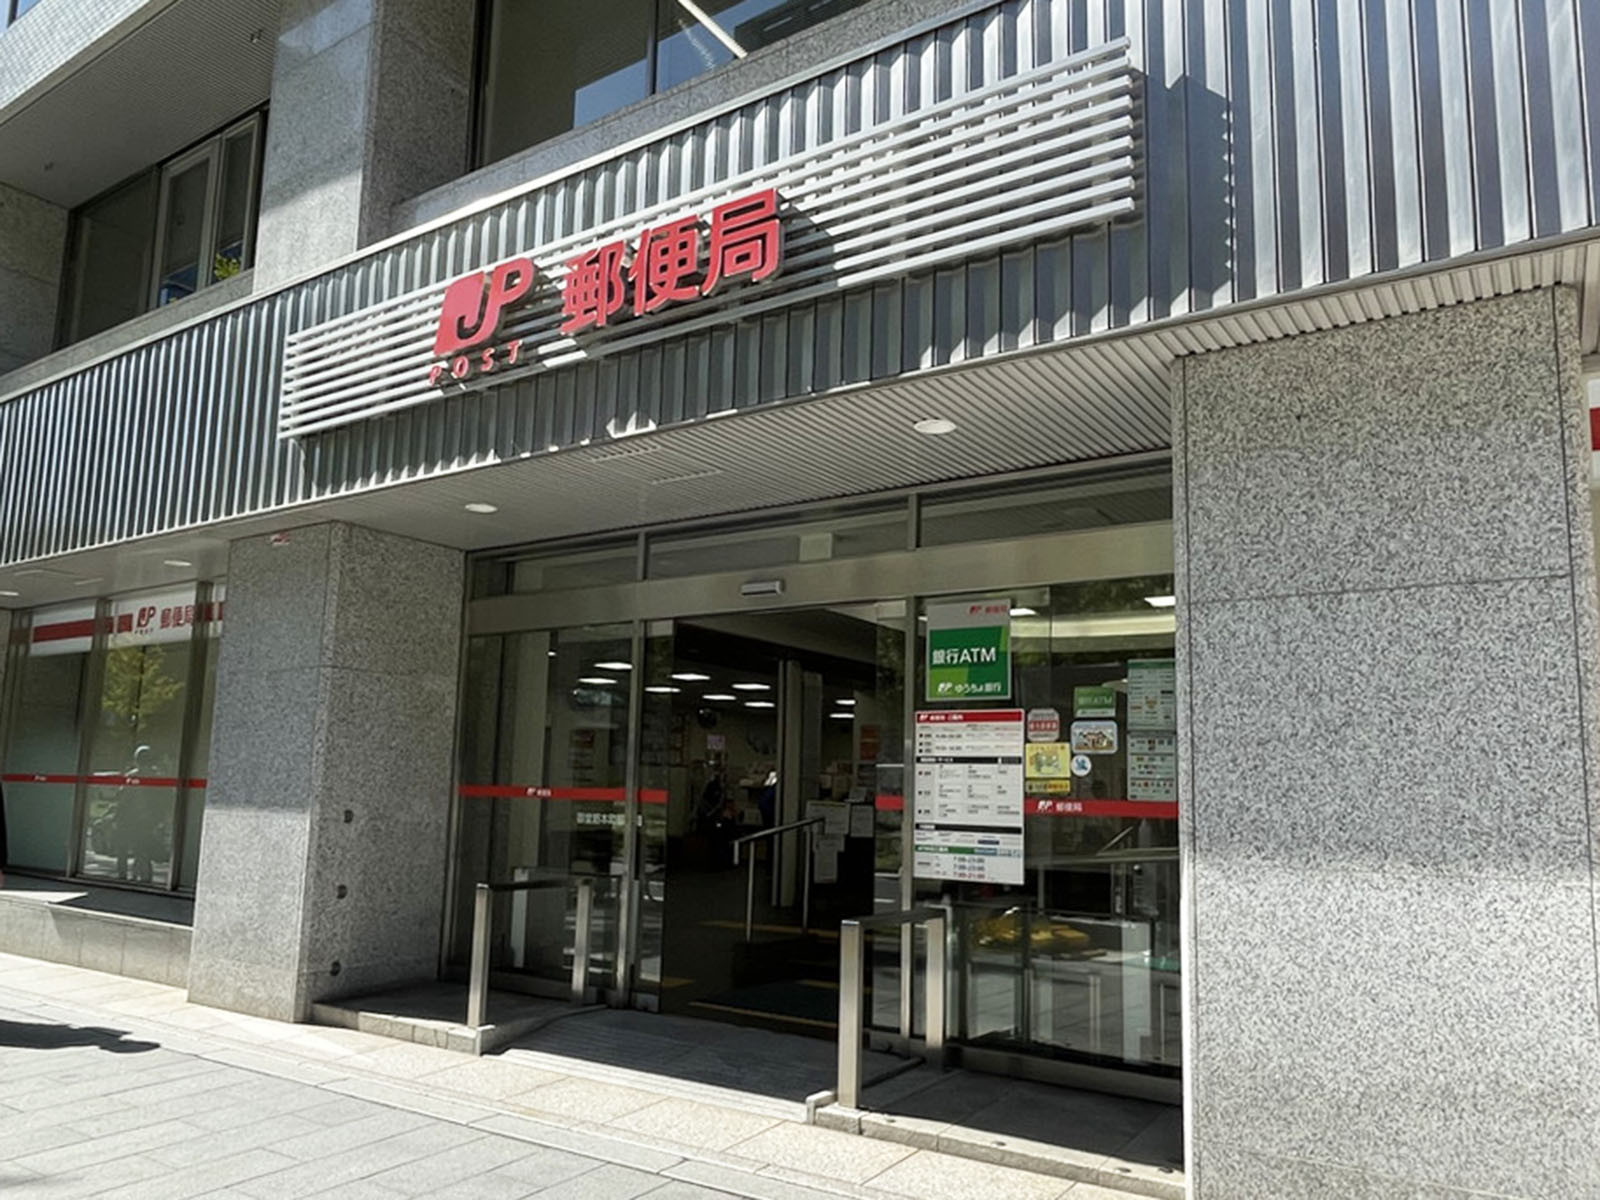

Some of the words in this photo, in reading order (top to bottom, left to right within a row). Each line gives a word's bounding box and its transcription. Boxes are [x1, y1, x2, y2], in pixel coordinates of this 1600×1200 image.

[560, 188, 783, 335] 郵便局
[429, 340, 523, 386] POST
[160, 605, 194, 629] 郵便局
[932, 647, 996, 665] 銀行ATM
[954, 682, 1002, 694] ゆうちょ銀行
